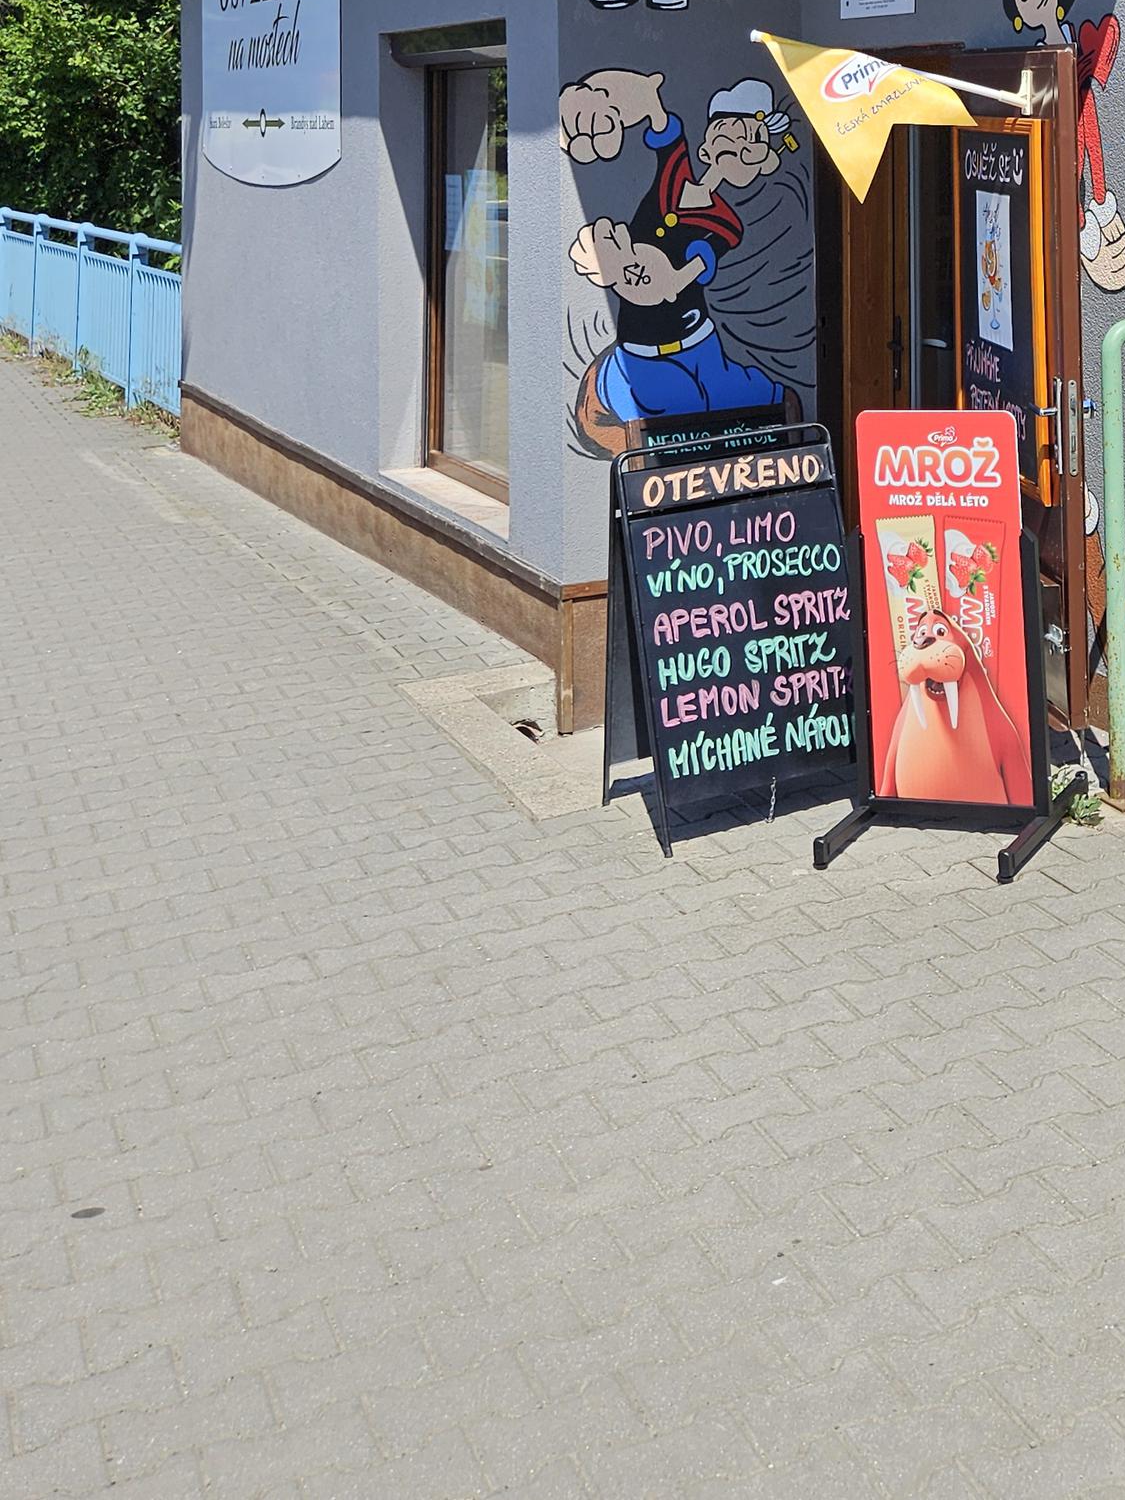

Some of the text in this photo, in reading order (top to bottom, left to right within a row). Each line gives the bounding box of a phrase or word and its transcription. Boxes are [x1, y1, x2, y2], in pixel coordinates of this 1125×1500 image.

[227, 0, 301, 72] na mostech
[836, 108, 871, 136] ČESKÁ
[642, 454, 820, 508] OTEVŘENO
[875, 437, 1001, 488] MROŽ
[889, 491, 990, 508] MROŽ DĚLÁ LÉTO
[643, 511, 796, 561] PIVO, LIMO
[723, 542, 841, 583] PROSECCO
[654, 586, 852, 647] APEROL SPRITZ
[657, 631, 838, 692] HUGO SPRITZ
[660, 679, 761, 728] LEMON
[668, 711, 780, 779] MÍCHANÉ
